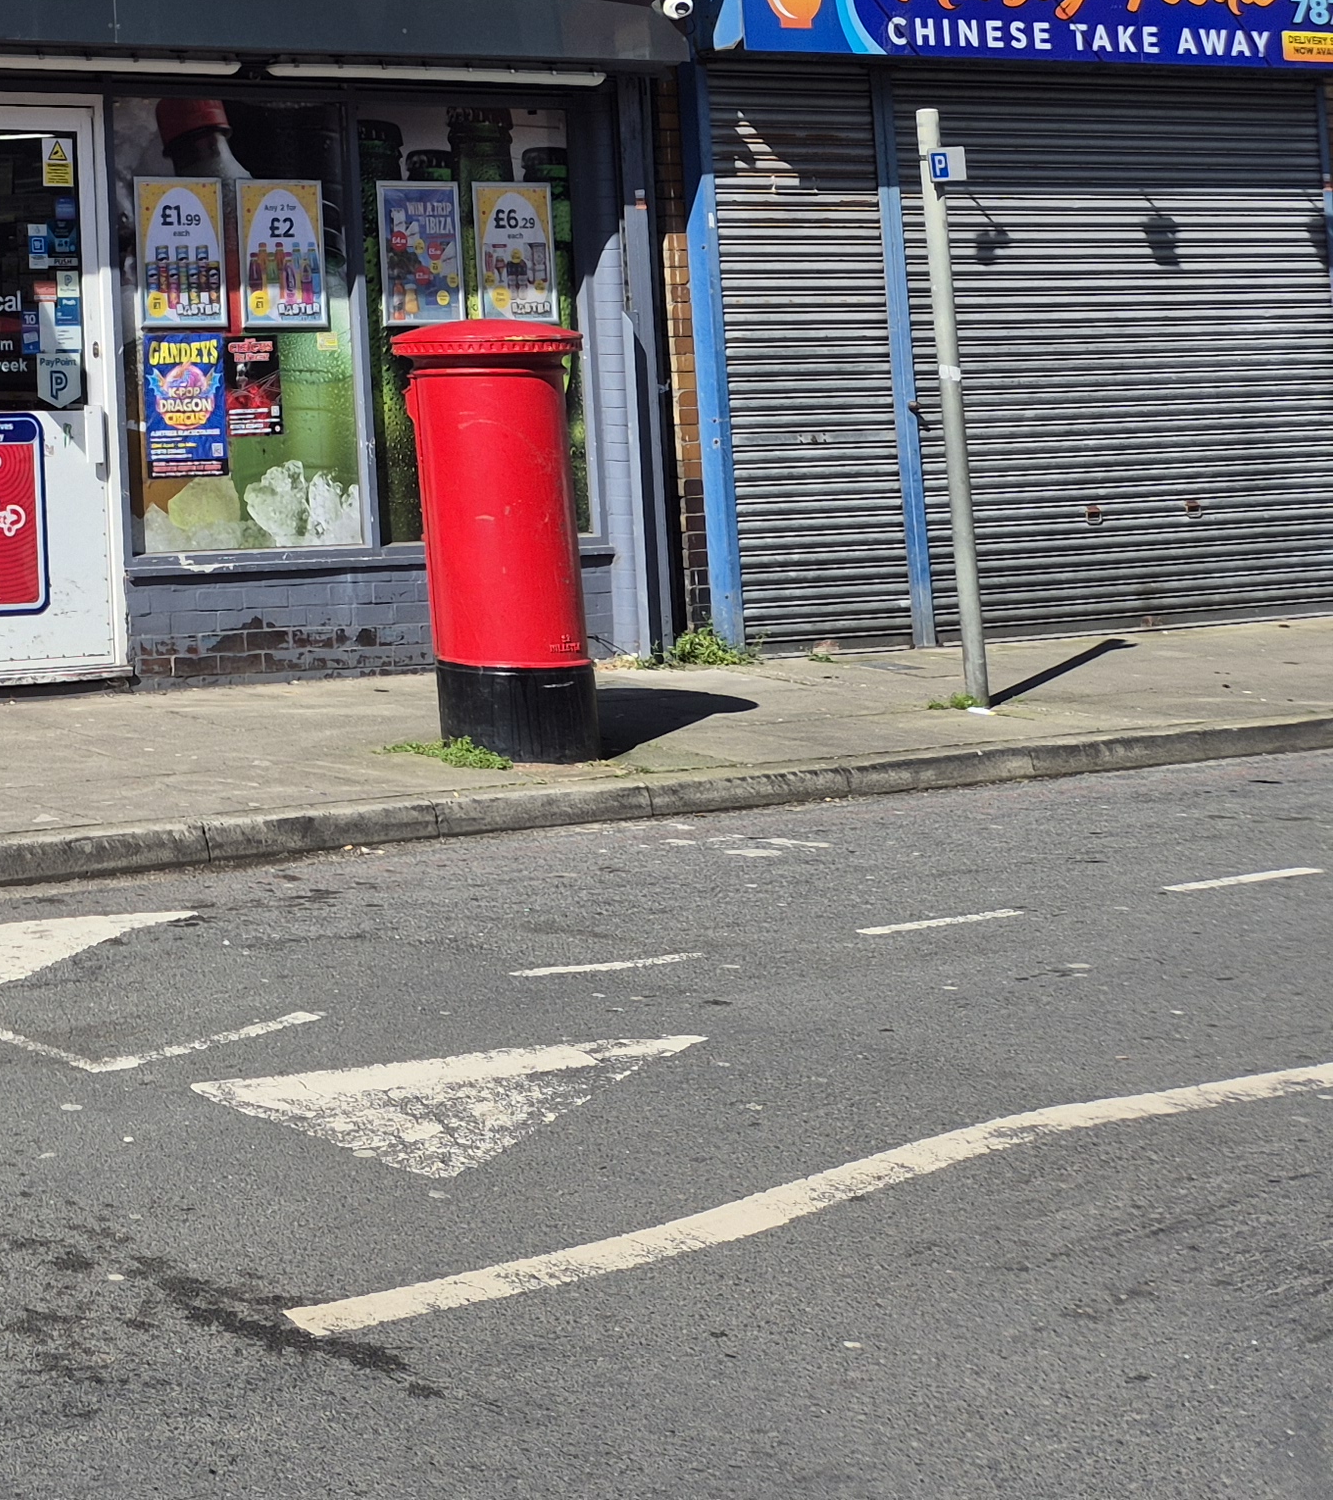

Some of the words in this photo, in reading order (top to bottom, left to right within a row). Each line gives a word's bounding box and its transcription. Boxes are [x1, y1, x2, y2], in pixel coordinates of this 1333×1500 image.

[887, 17, 1052, 50] CHINESE
[1071, 23, 1160, 55] TAKE
[1178, 28, 1270, 58] AWAY
[1288, 35, 1327, 45] DELIVERY
[934, 155, 945, 176] P
[161, 204, 201, 226] £1.99
[264, 204, 277, 212] Any
[426, 217, 454, 234] IBIZA
[494, 209, 535, 230] £6.29
[269, 217, 295, 238] £2
[176, 302, 220, 316] EASTER
[278, 302, 320, 316] EASTER
[39, 358, 77, 368] PayPoint
[168, 386, 200, 398] K-POP
[159, 398, 212, 412] DRAGON
[166, 412, 206, 425] CIRCUS
